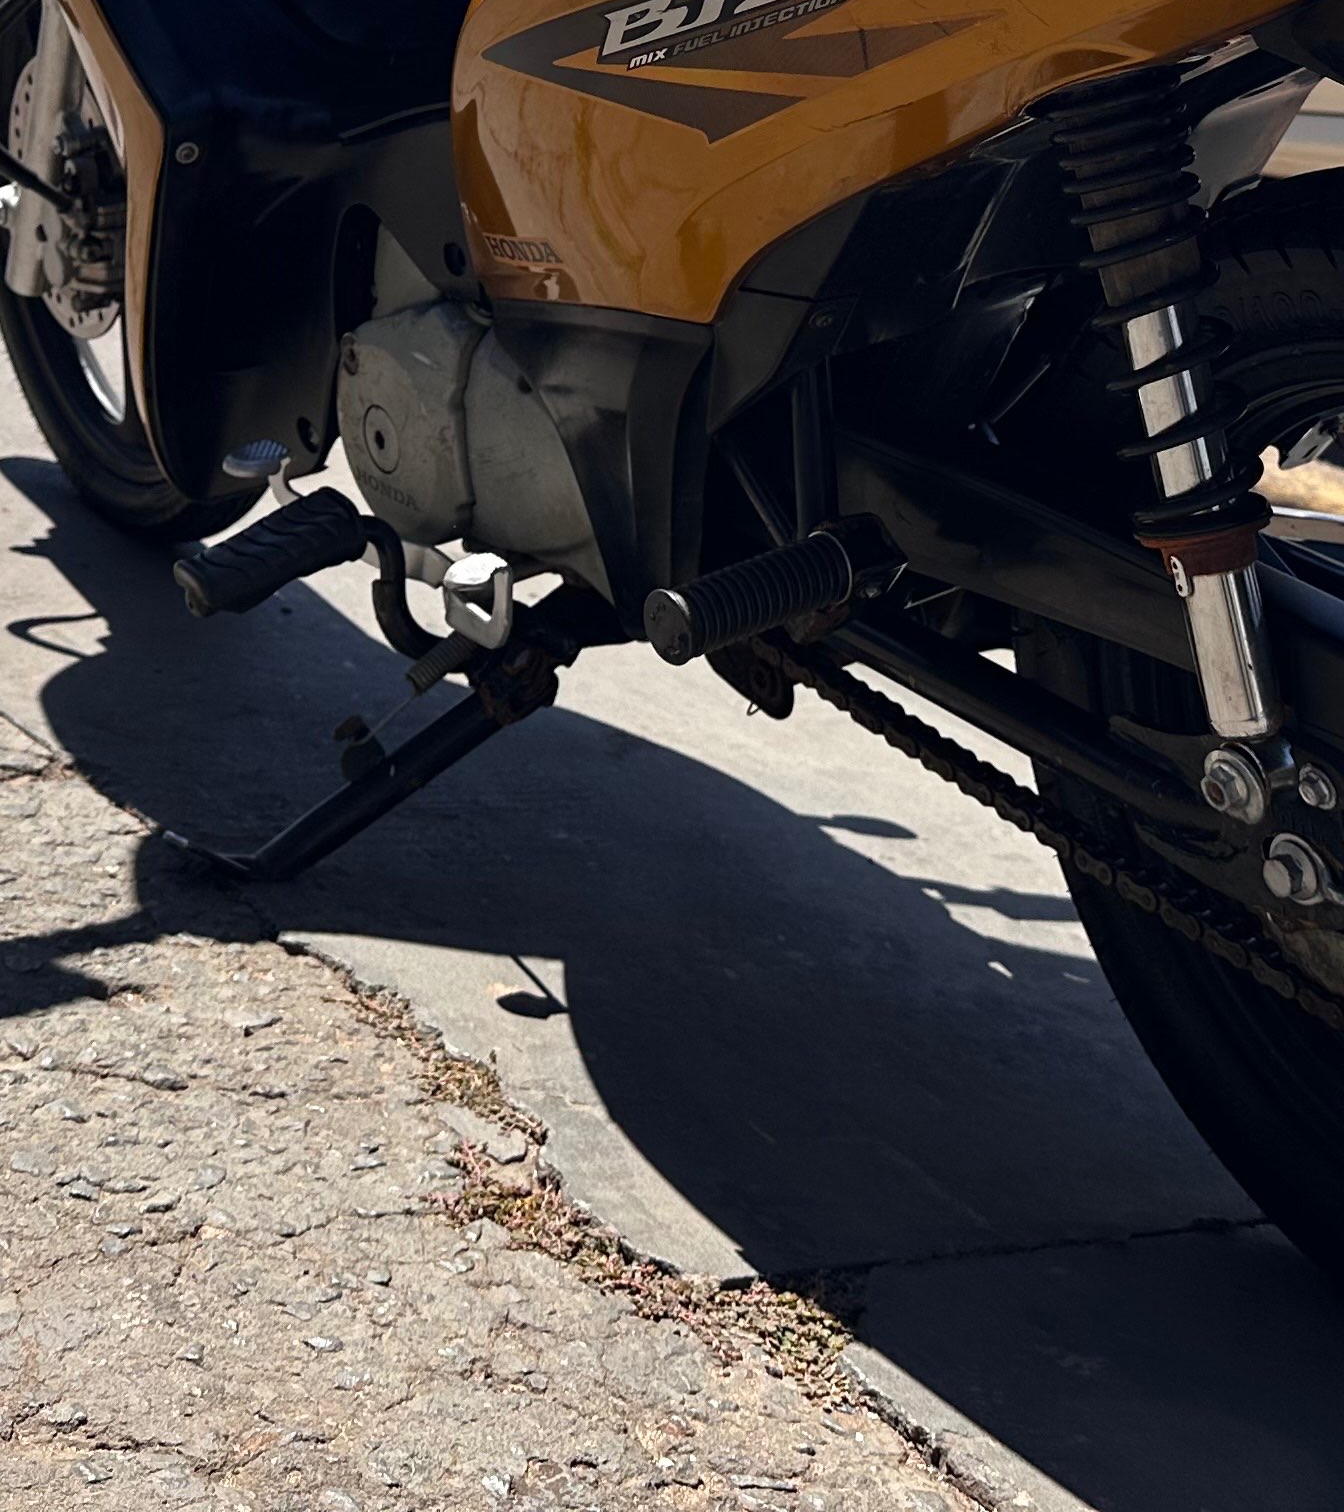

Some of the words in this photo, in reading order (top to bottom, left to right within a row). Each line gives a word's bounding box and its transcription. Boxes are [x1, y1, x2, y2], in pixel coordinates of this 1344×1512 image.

[672, 31, 724, 56] FUEL
[485, 234, 563, 266] HONDA
[356, 468, 423, 513] HONDA
